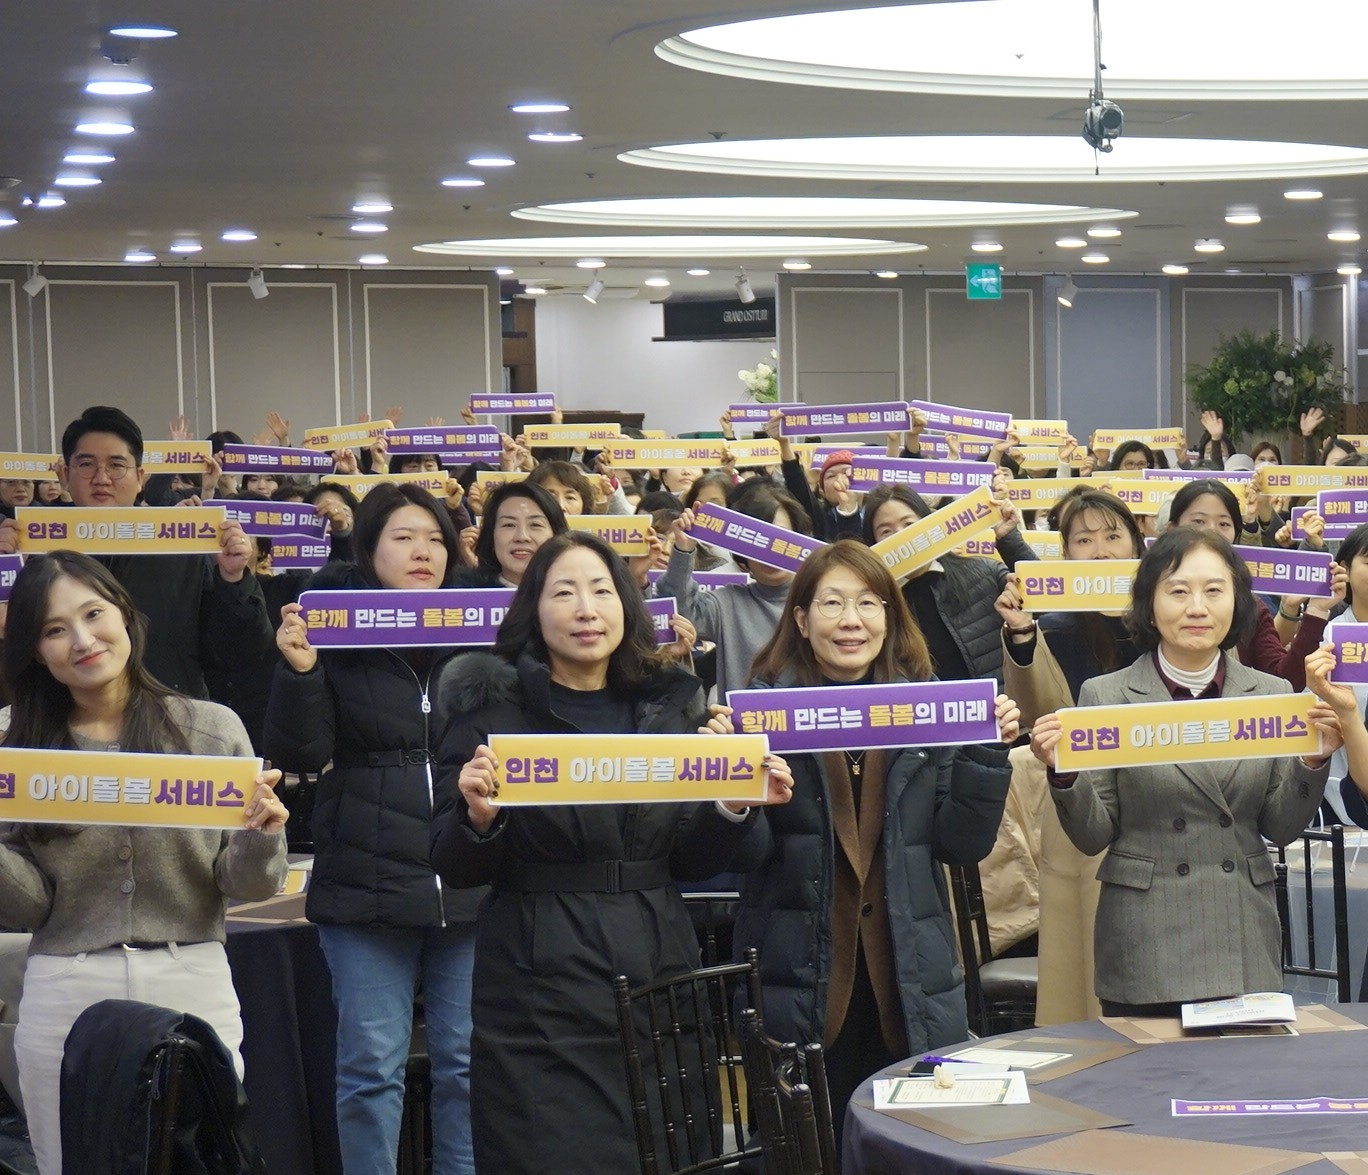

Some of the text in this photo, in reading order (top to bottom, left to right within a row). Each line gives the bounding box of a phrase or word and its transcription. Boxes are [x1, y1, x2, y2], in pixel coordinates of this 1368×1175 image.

[723, 308, 743, 323] GRAND
[490, 399, 513, 408] 만드는
[538, 398, 554, 408] 미래
[785, 410, 906, 426] 함께 만드는 돌봄의 미래
[924, 410, 1007, 433] 드는 돌봄의 미래
[311, 428, 385, 445] 인천 아이돌봄서비
[390, 432, 499, 446] 함께 만드는 돌봄의 미래
[1347, 439, 1360, 448] 천
[224, 452, 333, 468] 함께 만드는 돌봄의 미래
[613, 448, 636, 460] 인천
[853, 468, 993, 487] 함께 만드는 돌봄의 미래
[1267, 474, 1291, 486] 인천
[1008, 488, 1032, 501] 인천
[1117, 490, 1144, 503] 인천
[1324, 501, 1351, 514] 함께
[226, 510, 252, 524] 드는
[255, 511, 296, 526] 돌봄의
[27, 521, 217, 540] 인천 아이돌봄서비스
[693, 512, 725, 534] 함께
[724, 522, 770, 549] 만드는
[272, 544, 331, 558] 함께 만드
[965, 540, 997, 555] 인천
[1, 569, 16, 588] 래
[1295, 564, 1327, 583] 미래
[1025, 576, 1065, 595] 인천
[306, 609, 348, 629] 함께
[355, 608, 417, 629] 만드는
[423, 607, 484, 628] 돌봄의
[653, 614, 670, 631] 래
[740, 699, 987, 733] 함께 만드는 돌봄의 미래
[1070, 714, 1308, 752] 인천 아이돌봄서비스
[505, 756, 754, 785] 인천 아이돌봄서비스
[0, 773, 245, 808] 천 아이돌봄서비스
